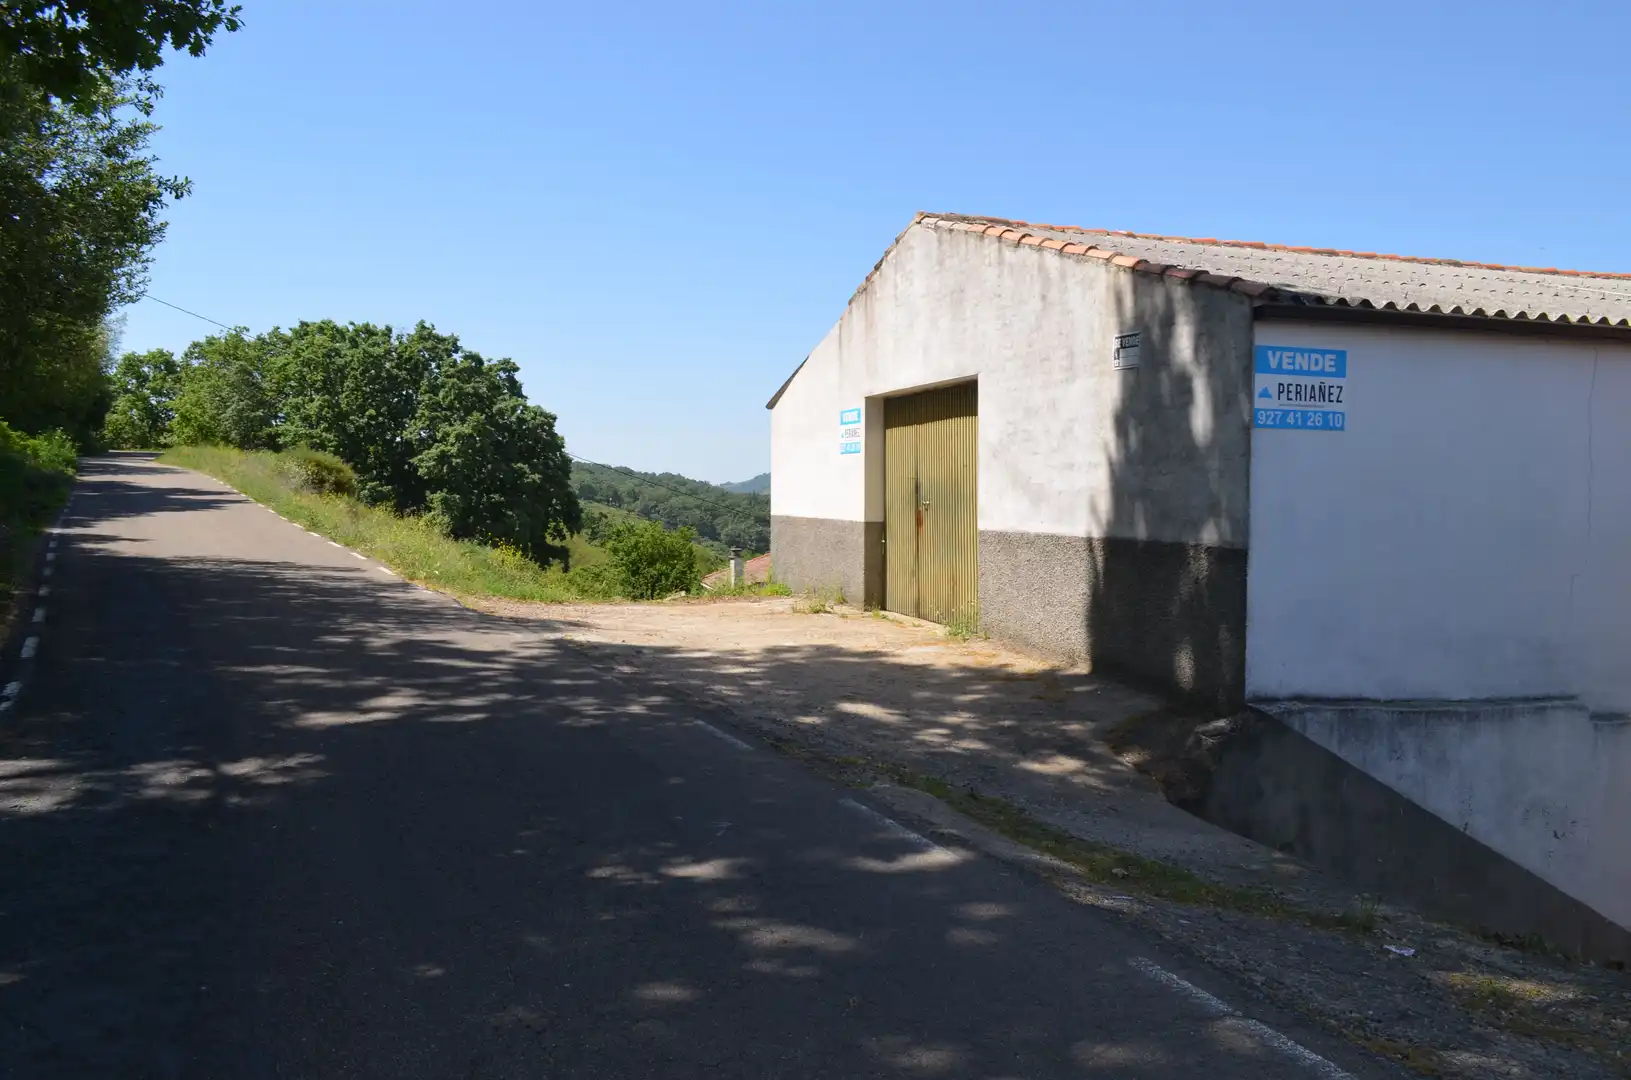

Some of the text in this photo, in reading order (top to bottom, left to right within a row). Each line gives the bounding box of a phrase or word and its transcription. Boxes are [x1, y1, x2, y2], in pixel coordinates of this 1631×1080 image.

[1122, 335, 1140, 348] VENDE
[1267, 350, 1337, 372] VENDE
[1277, 381, 1344, 403] PERIAÑEZ
[1257, 411, 1343, 428] 927 41 26 10
